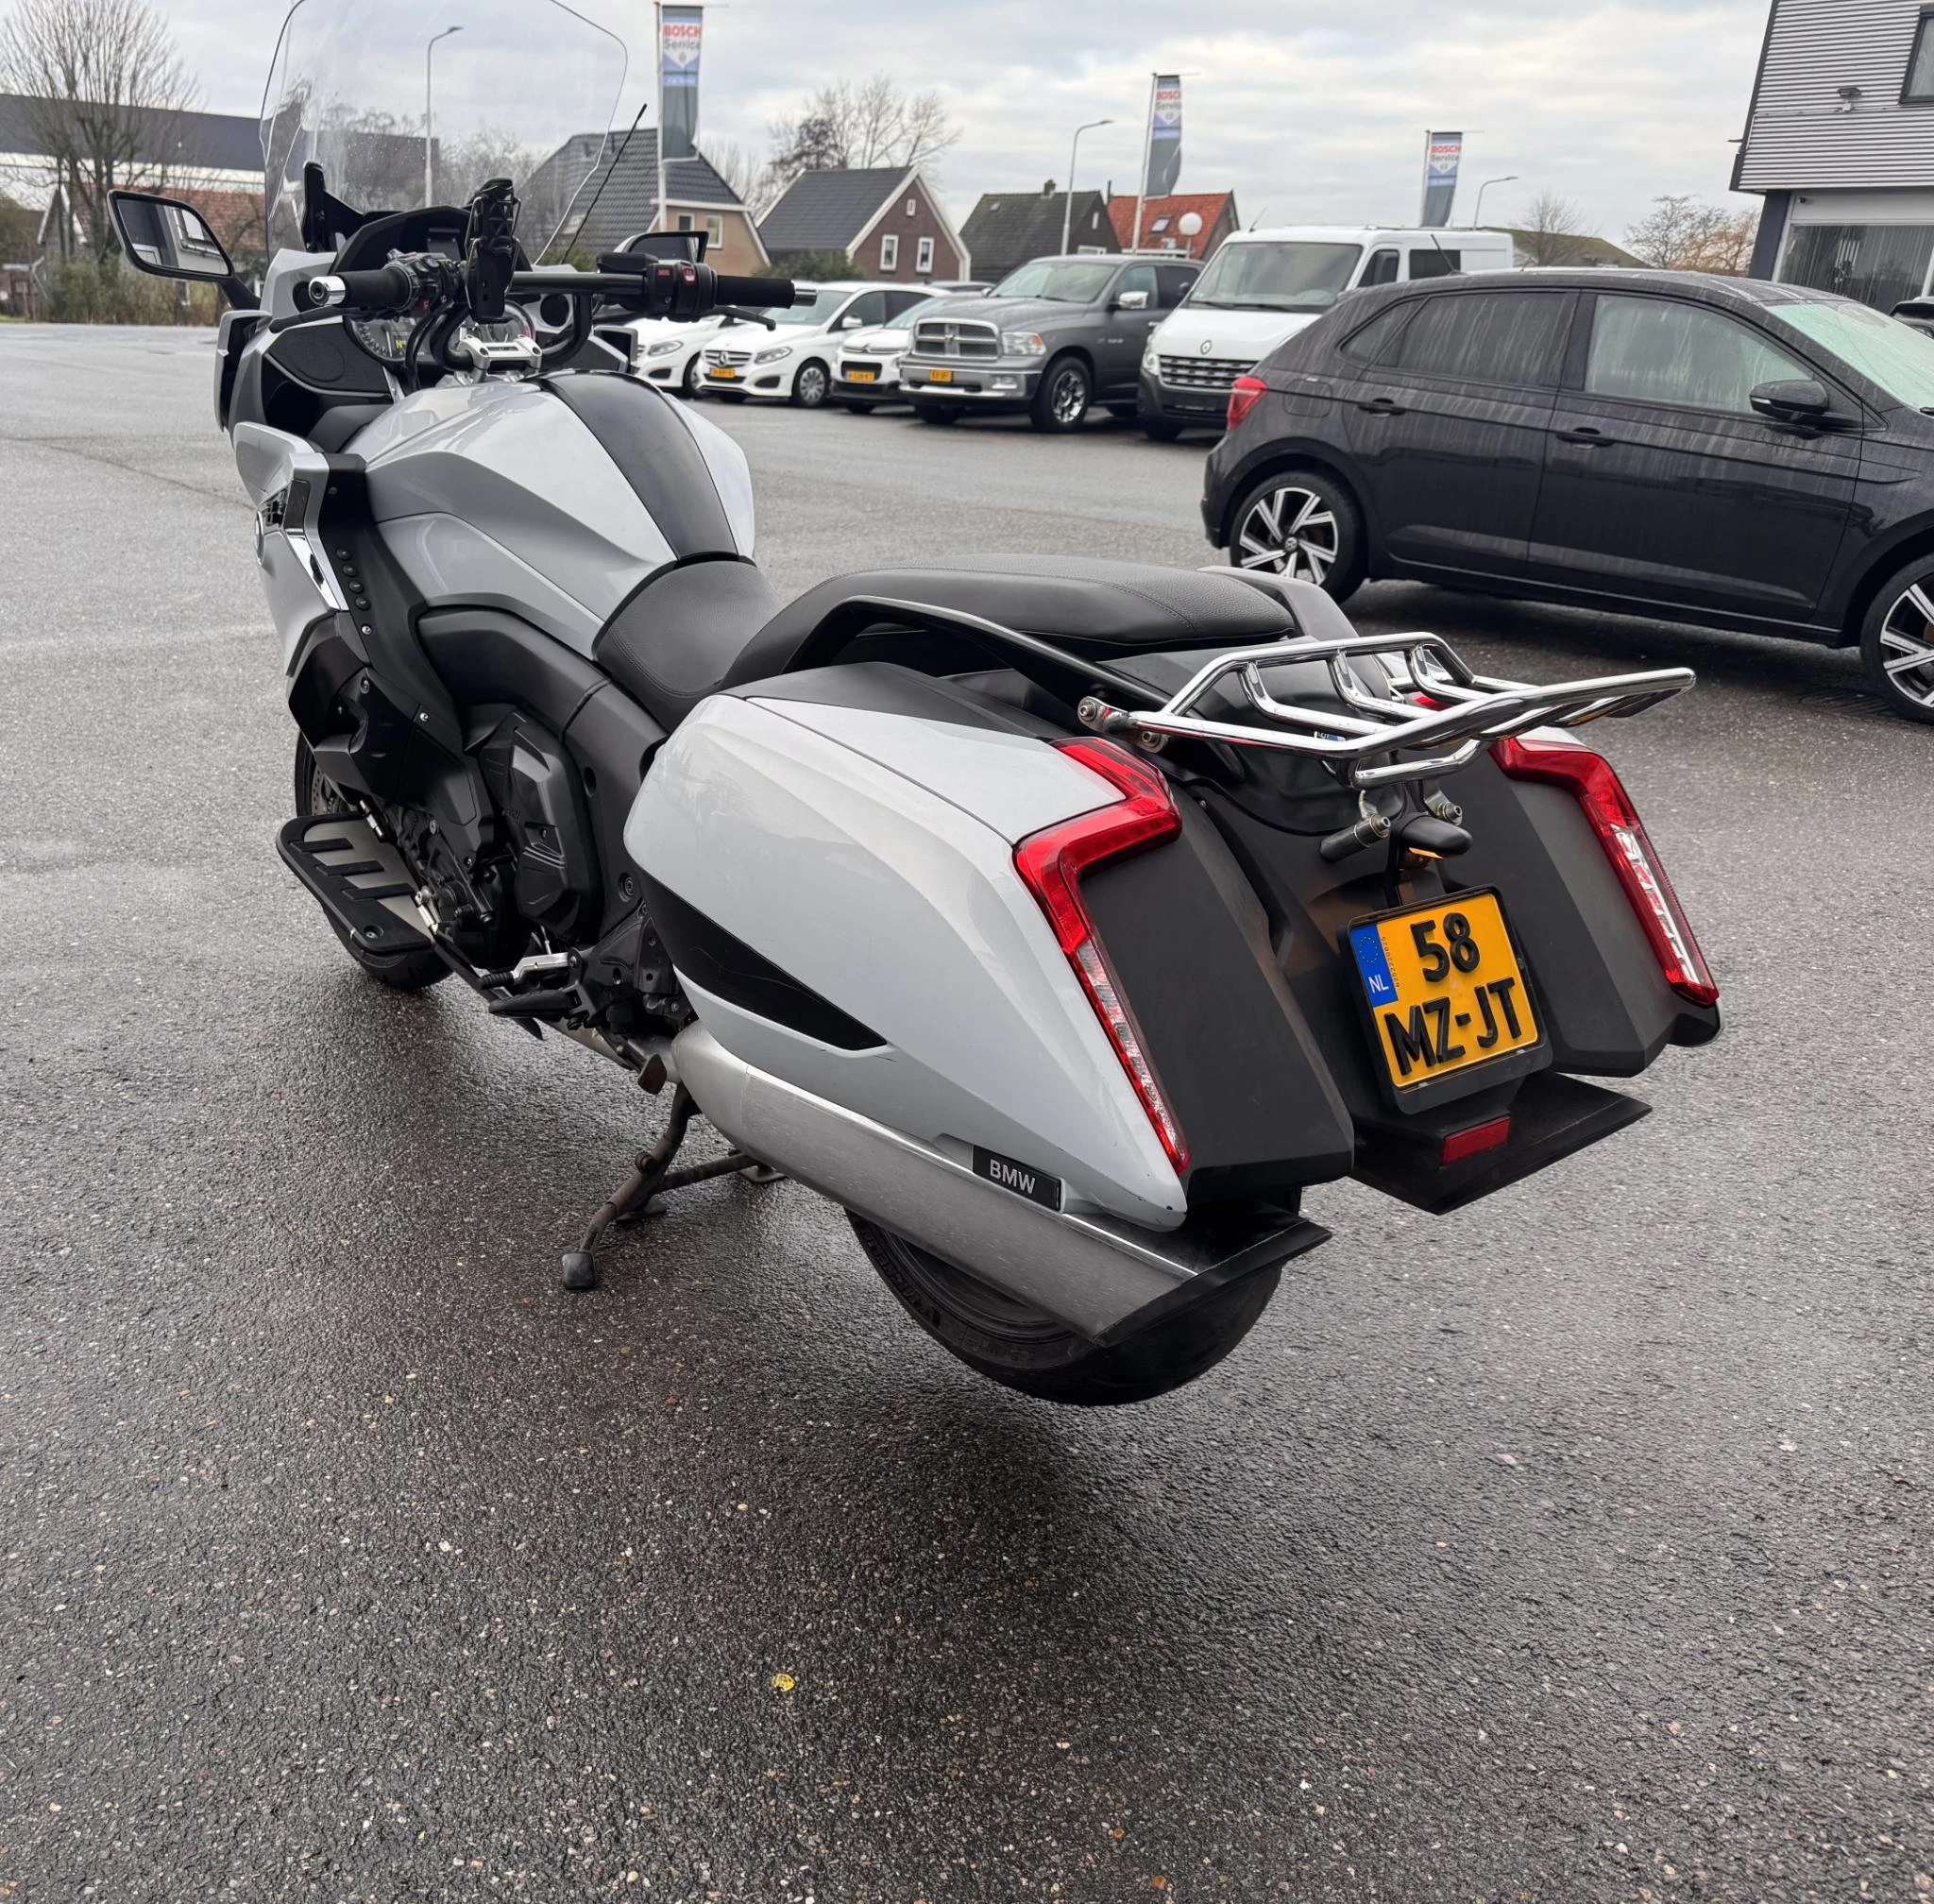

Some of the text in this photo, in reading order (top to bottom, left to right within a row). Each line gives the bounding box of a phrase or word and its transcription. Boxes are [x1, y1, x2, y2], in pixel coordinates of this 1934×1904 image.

[664, 25, 702, 37] BOSCH
[1410, 912, 1480, 982] 58
[1368, 974, 1389, 994] NL
[1383, 977, 1522, 1076] MZ-JT
[990, 1159, 1036, 1195] BMW
